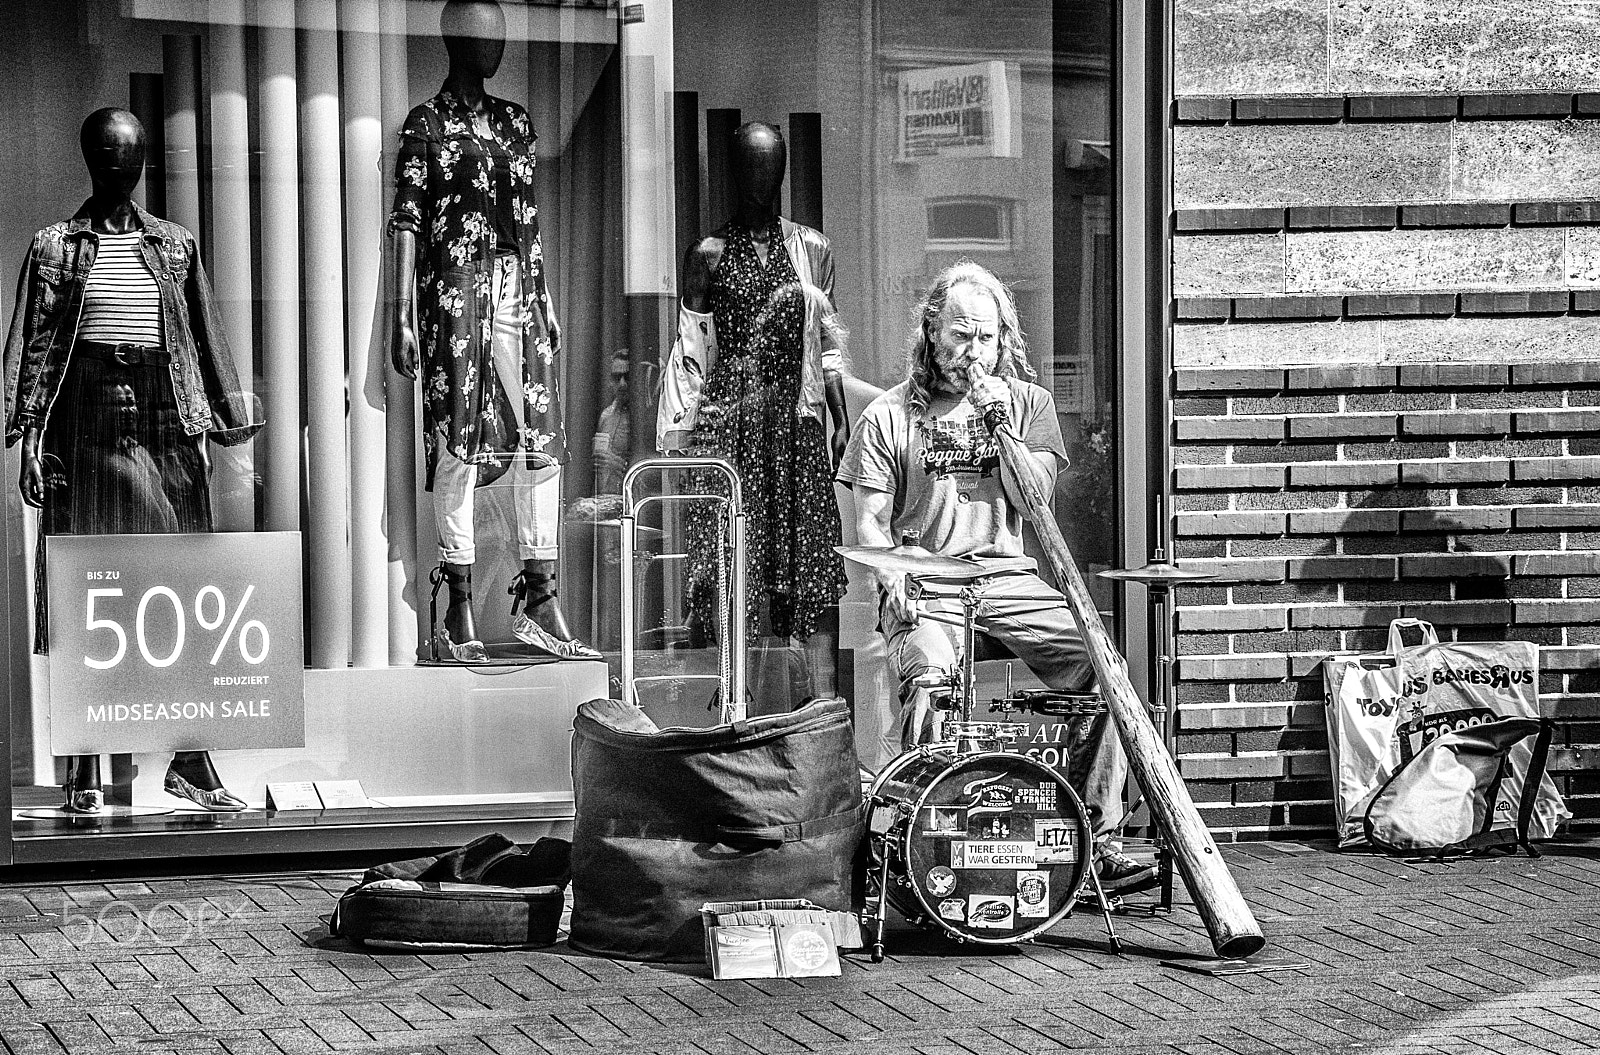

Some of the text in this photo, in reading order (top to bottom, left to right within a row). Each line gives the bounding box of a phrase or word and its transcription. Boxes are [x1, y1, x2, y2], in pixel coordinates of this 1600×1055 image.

[915, 447, 972, 467] Reggae
[86, 571, 120, 580] BIS ZU
[83, 584, 270, 670] 50%
[213, 676, 269, 686] REDUZIERT
[86, 700, 270, 723] MIDSEASON SALE
[1030, 723, 1068, 744] AT
[1017, 788, 1057, 796] SPENCER
[982, 799, 1013, 807] WELCOME
[1014, 796, 1057, 804] & TRANCE
[1036, 803, 1057, 811] HILL
[1037, 827, 1076, 847] JETZT
[968, 844, 1023, 854] TIERE ESSEN
[968, 855, 1035, 864] WAR GESTERN
